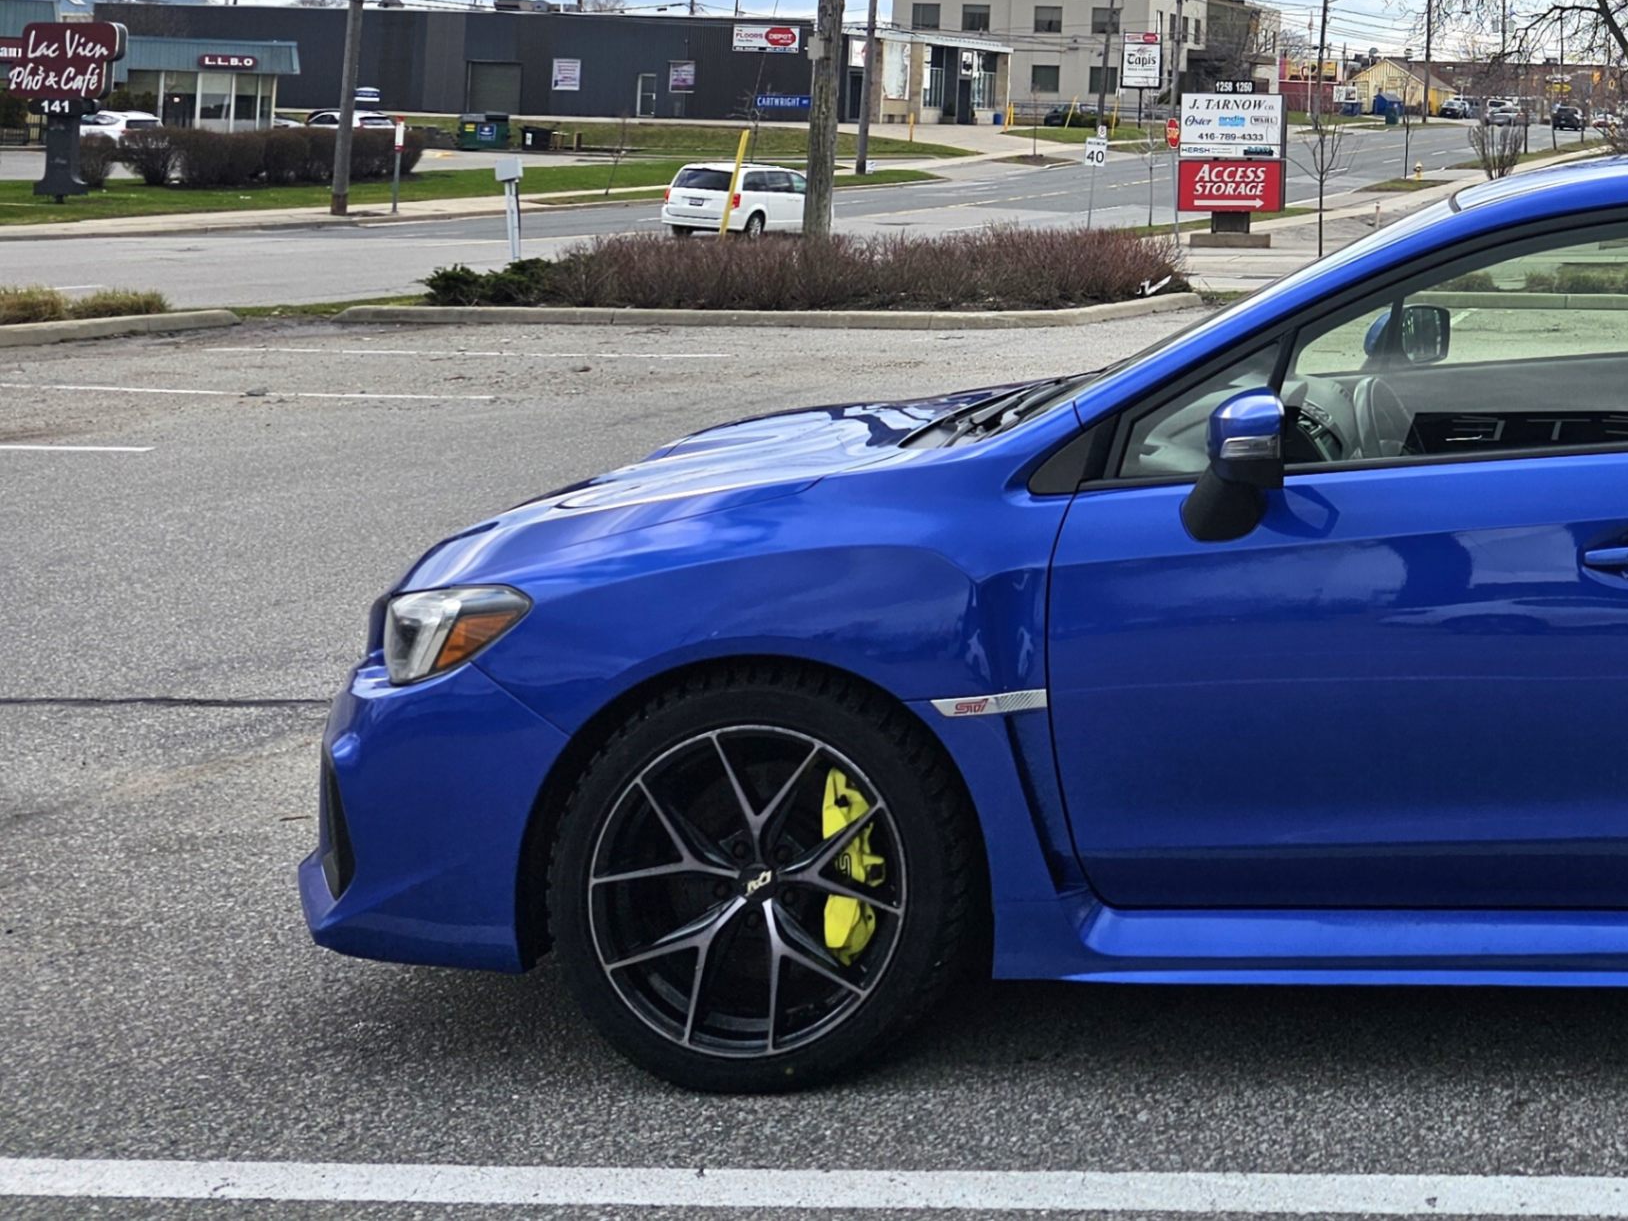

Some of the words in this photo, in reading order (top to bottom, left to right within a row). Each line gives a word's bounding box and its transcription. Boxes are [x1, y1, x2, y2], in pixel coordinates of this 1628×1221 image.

[27, 30, 59, 58] Lac
[65, 29, 109, 58] Vien
[1127, 53, 1157, 67] Tapis
[45, 72, 58, 89] &
[60, 63, 100, 97] Café
[41, 100, 70, 113] 141
[757, 96, 800, 107] CARTWRIGHT
[1189, 98, 1200, 110] J.
[1205, 98, 1266, 111] TARNOW
[1184, 114, 1212, 127] Oster
[1086, 150, 1104, 163] 40
[1195, 164, 1266, 182] ACCESS
[1193, 182, 1266, 195] STORAGE
